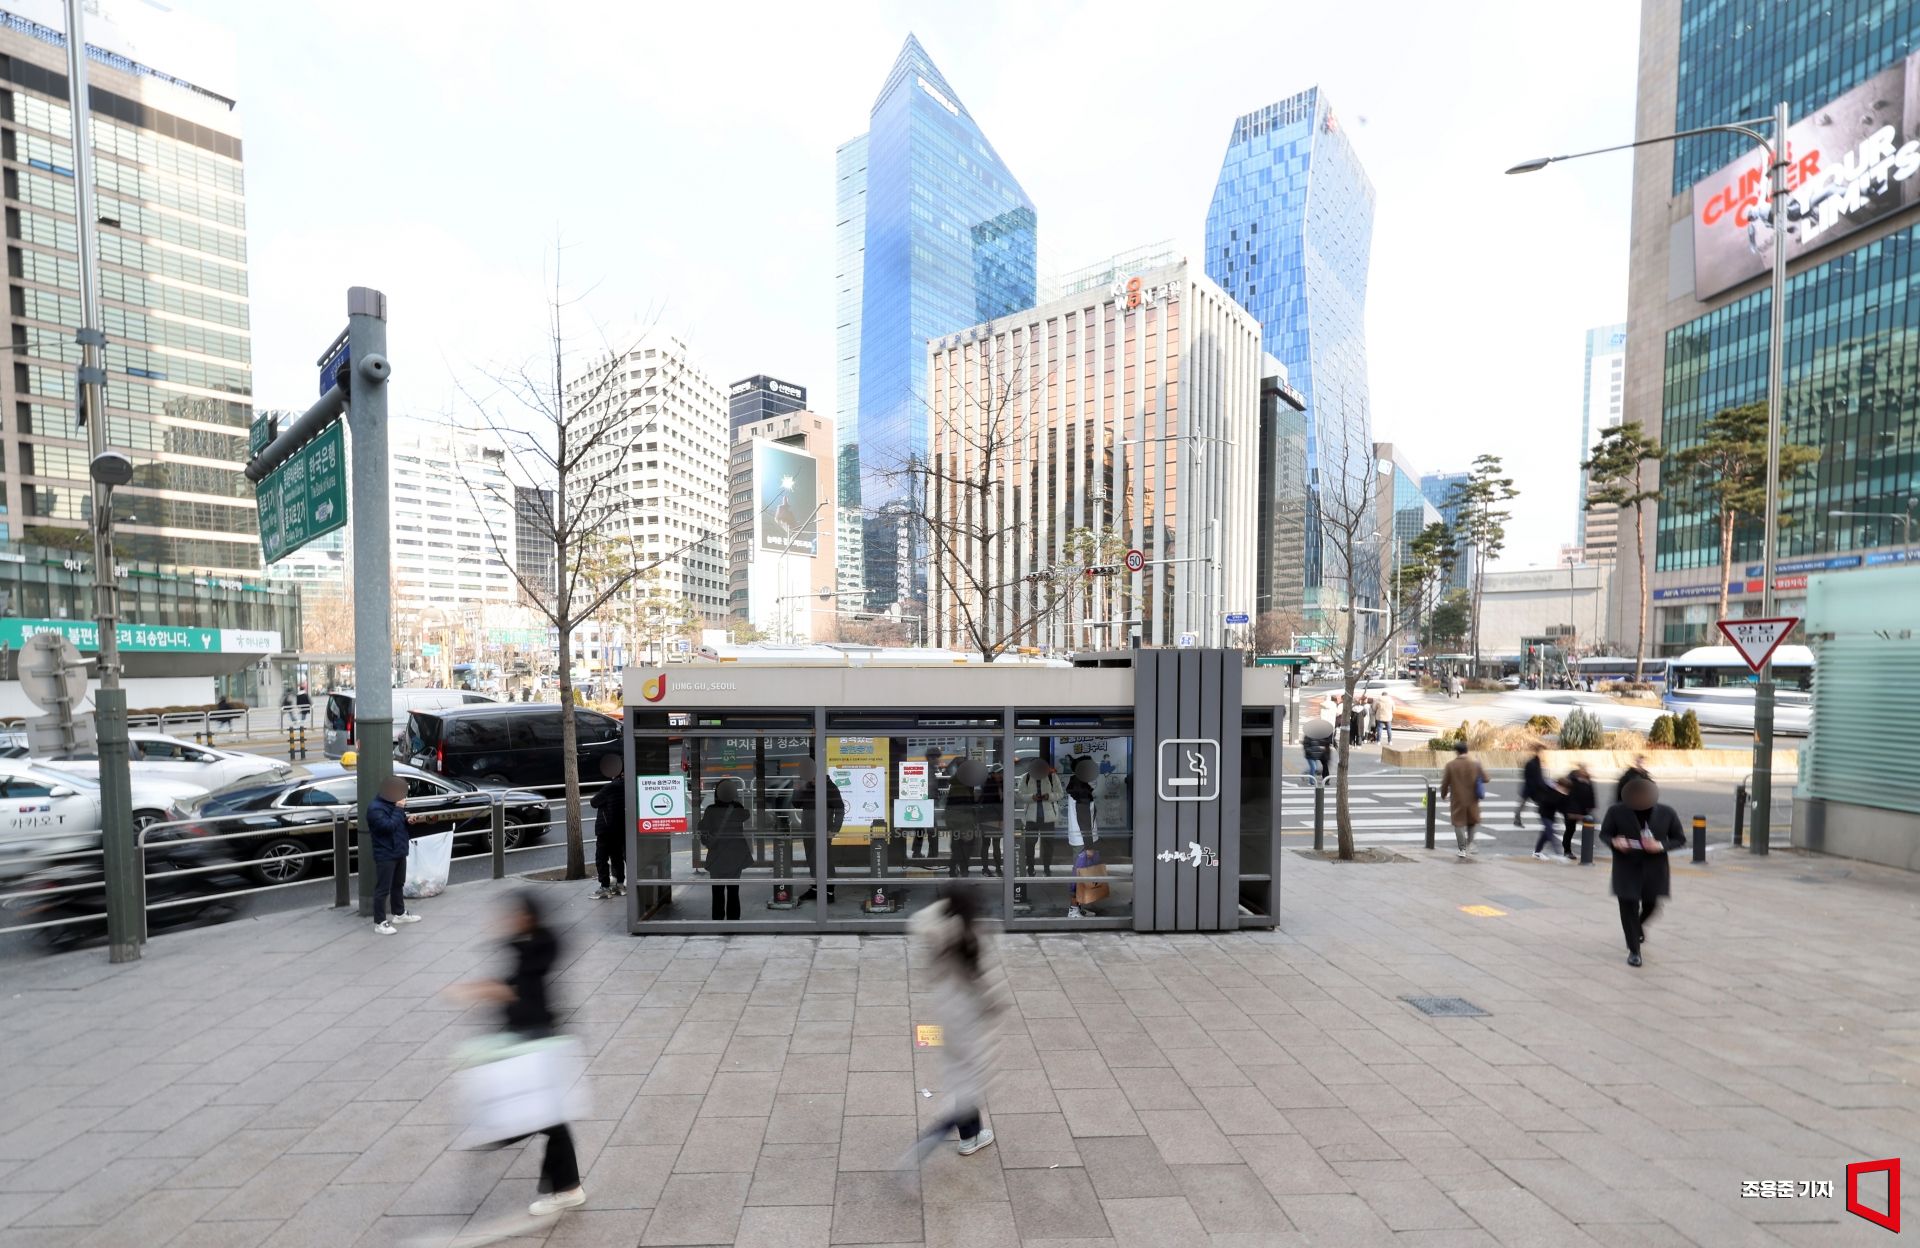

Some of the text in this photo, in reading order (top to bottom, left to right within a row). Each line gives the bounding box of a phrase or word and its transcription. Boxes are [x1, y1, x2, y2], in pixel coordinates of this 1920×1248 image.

[1793, 124, 1897, 216] YOUR
[309, 440, 336, 482] 한국은행
[284, 497, 306, 530] 을지로2가
[1129, 555, 1141, 567] 50
[1737, 624, 1775, 635] 양보
[136, 631, 191, 648] 죄송합니다.
[1738, 634, 1774, 644] YIELD
[672, 682, 692, 691] JUNG
[710, 682, 737, 691] SEOUL
[894, 828, 927, 839] Seoul
[931, 826, 982, 841] Jung-gu
